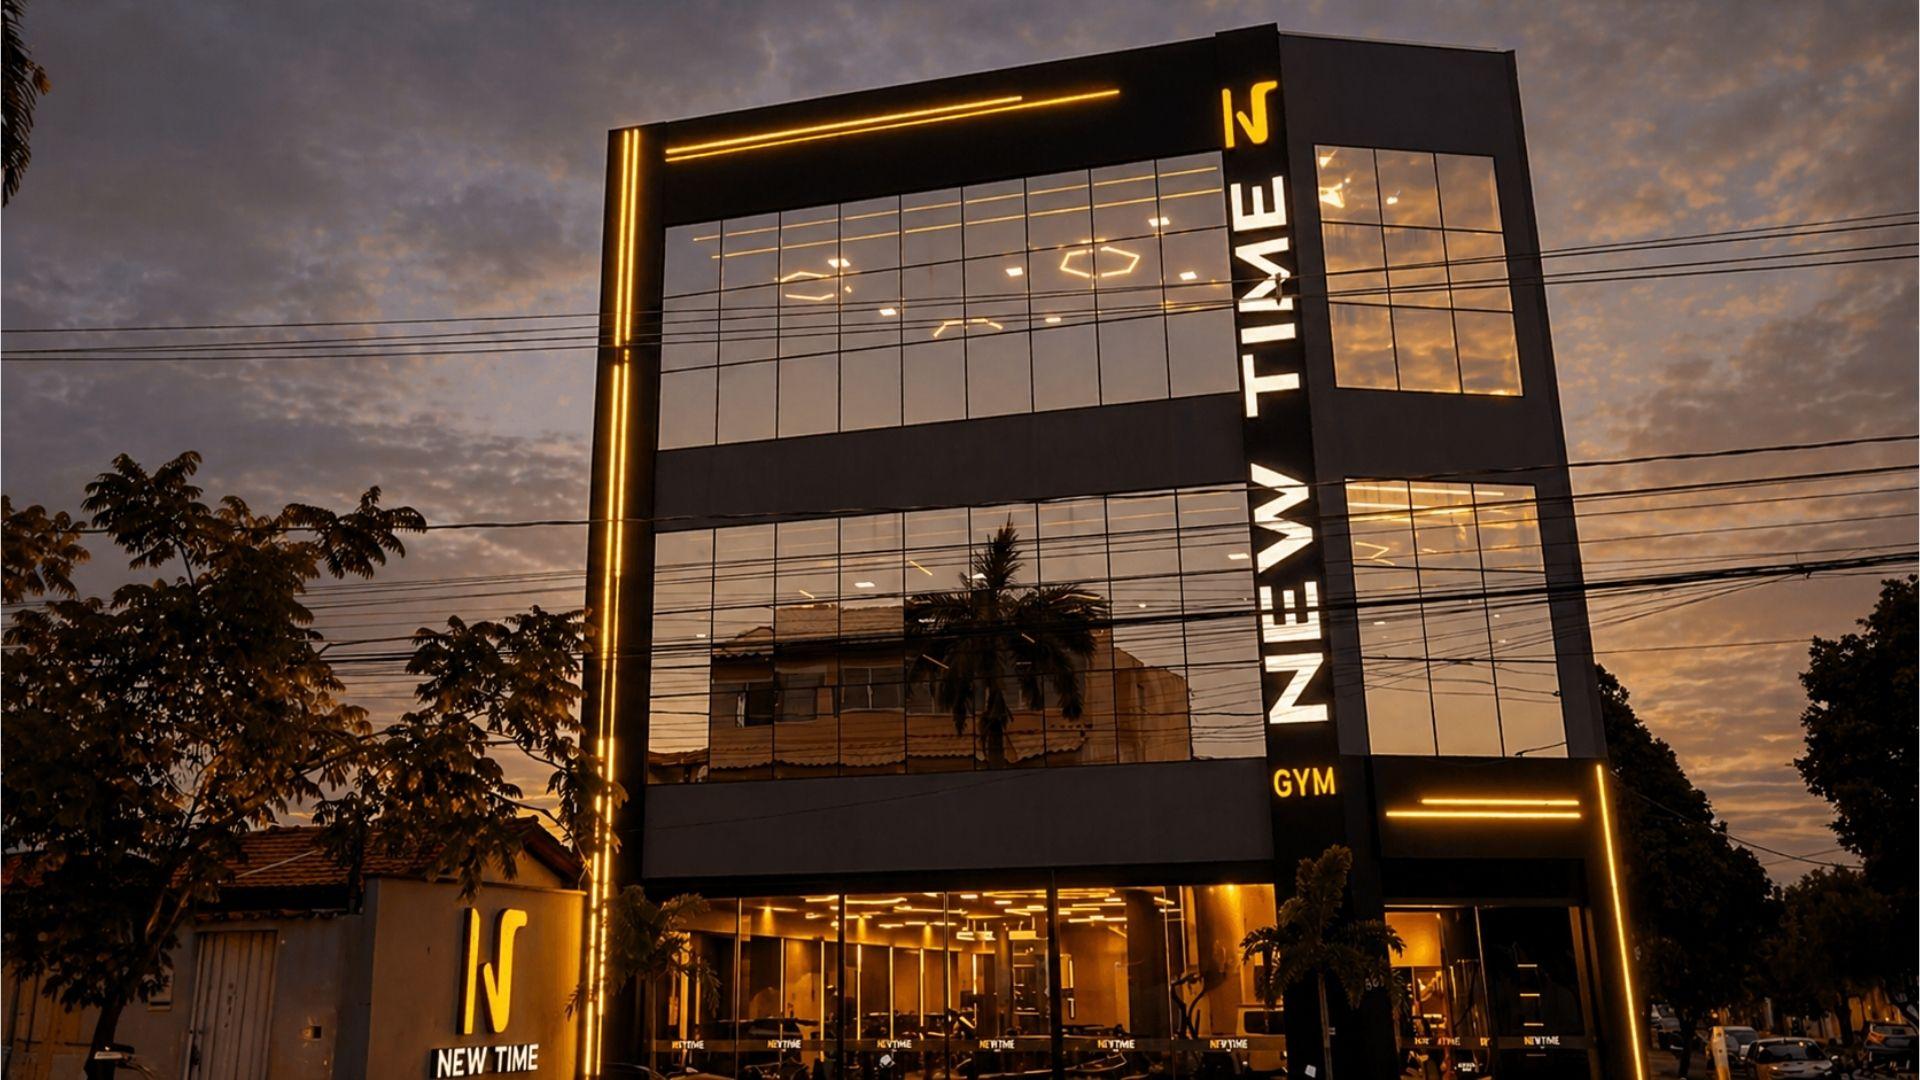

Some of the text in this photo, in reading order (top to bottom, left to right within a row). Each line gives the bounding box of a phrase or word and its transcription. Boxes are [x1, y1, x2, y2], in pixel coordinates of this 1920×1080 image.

[1229, 176, 1329, 725] NEW TIME
[1273, 767, 1336, 798] GYM
[437, 1044, 539, 1078] NEW TIME
